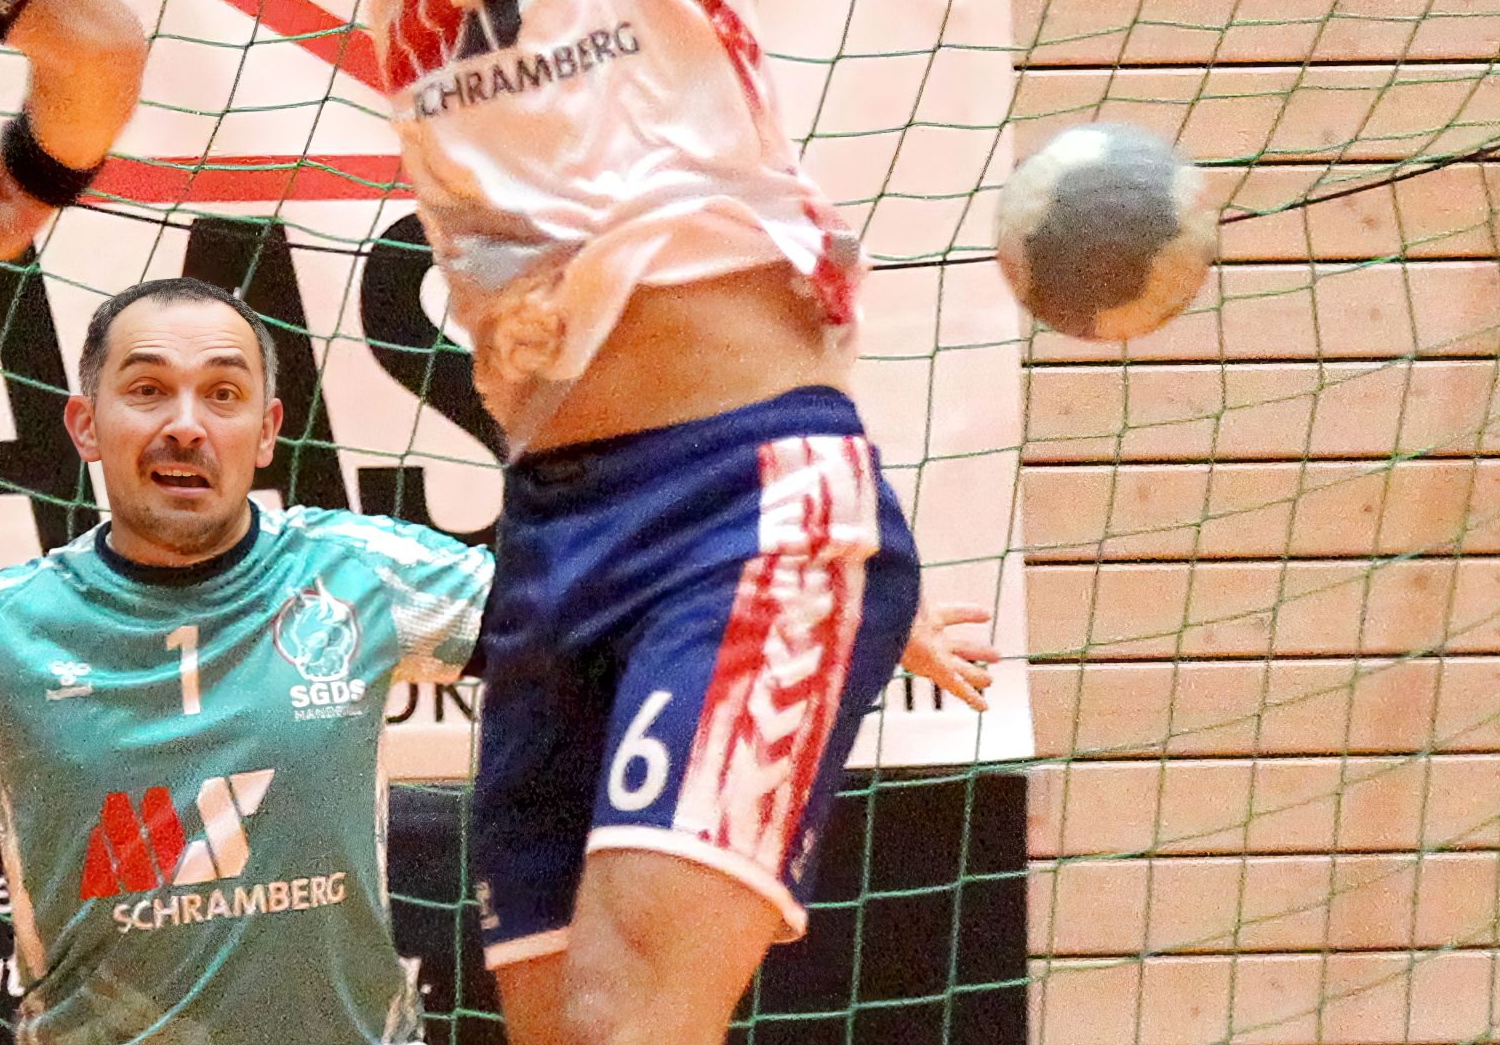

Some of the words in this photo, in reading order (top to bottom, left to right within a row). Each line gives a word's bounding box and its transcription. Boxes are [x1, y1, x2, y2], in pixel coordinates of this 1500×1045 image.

[414, 22, 639, 121] CHRAMBERG
[165, 625, 201, 716] 1
[290, 678, 367, 708] SGDS
[607, 690, 673, 812] 6
[112, 871, 348, 934] SCHRAMBERG
